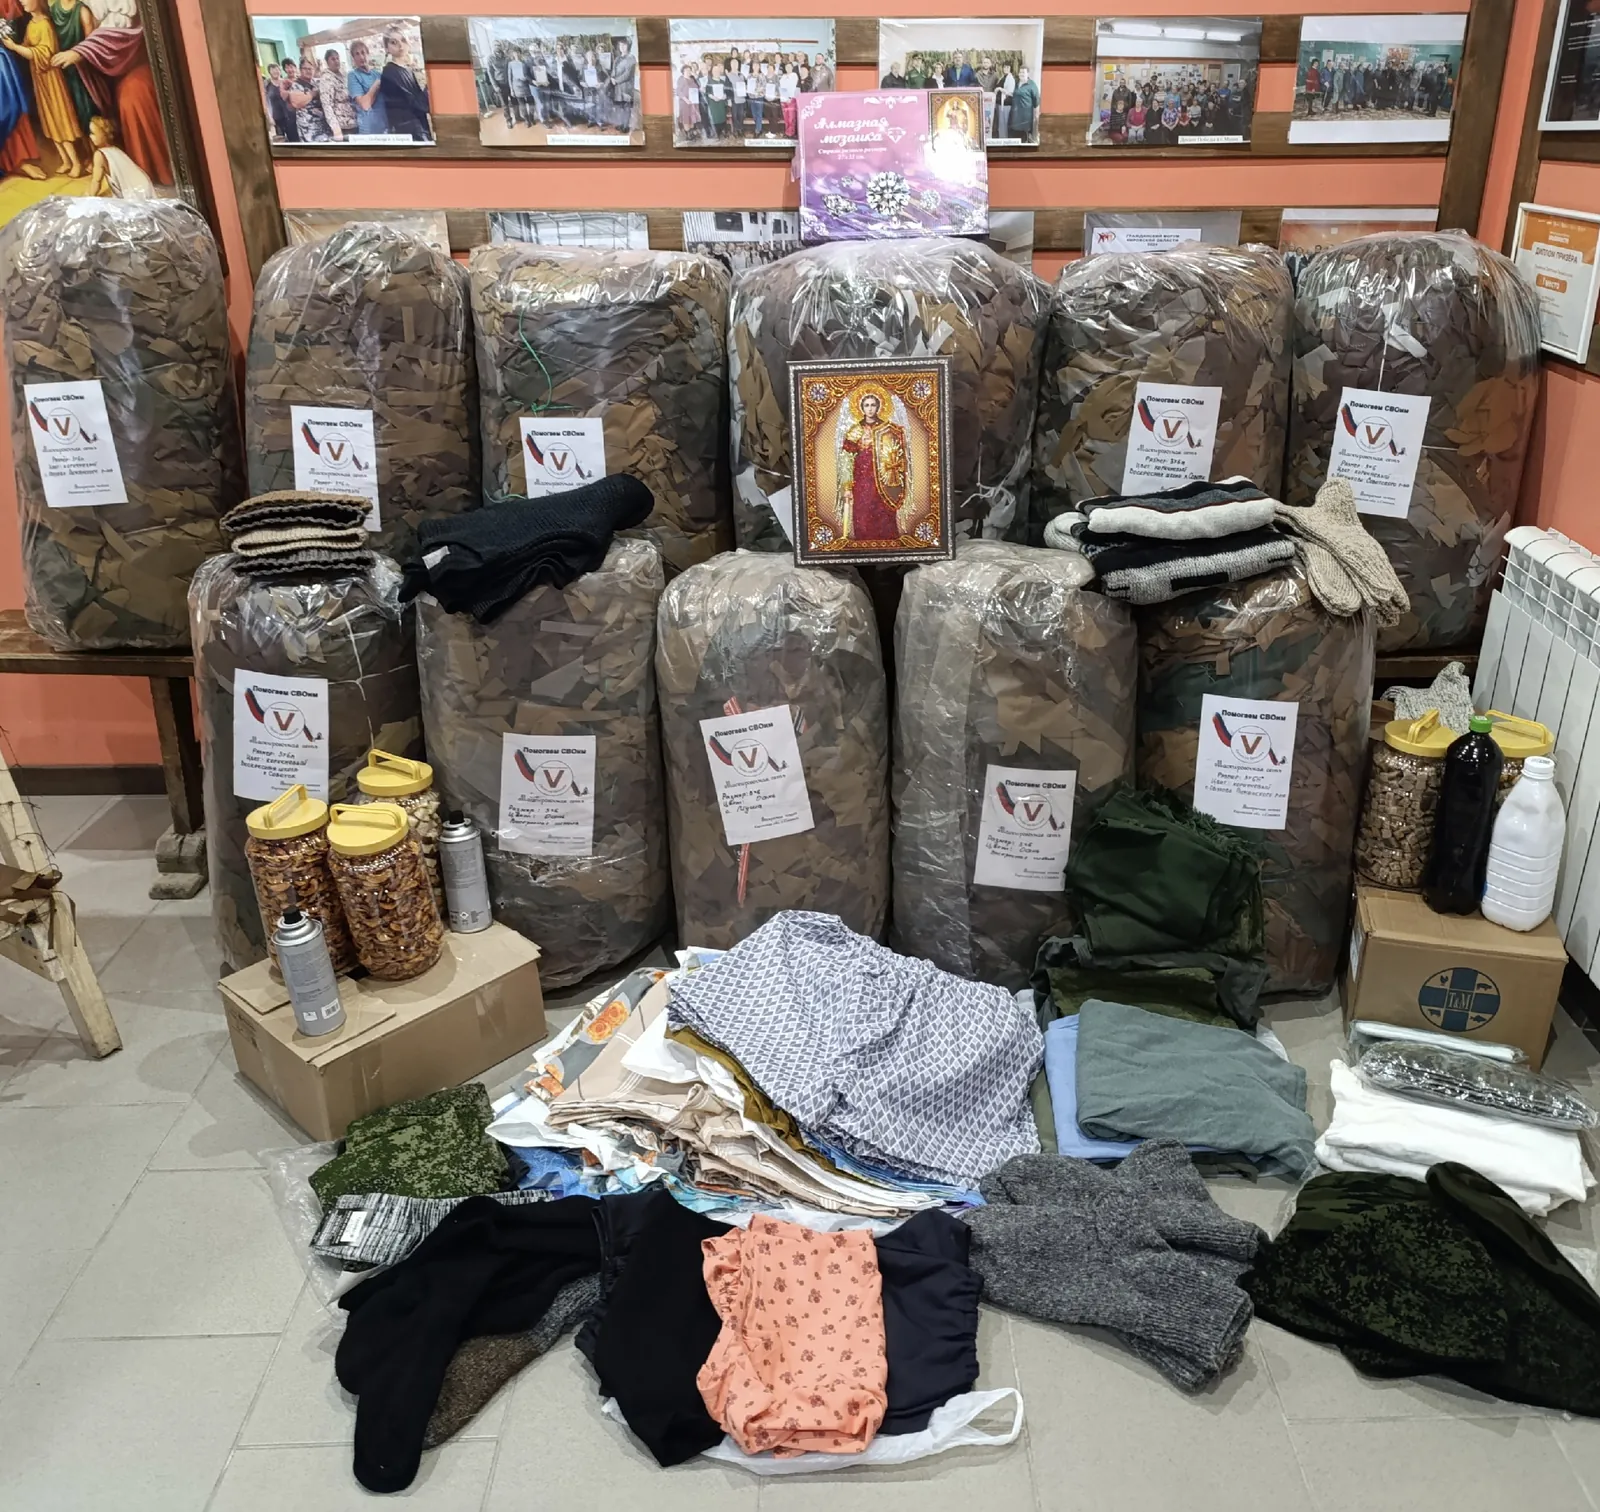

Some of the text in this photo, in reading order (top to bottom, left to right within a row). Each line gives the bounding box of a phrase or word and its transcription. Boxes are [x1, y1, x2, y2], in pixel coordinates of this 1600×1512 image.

[814, 117, 889, 132] Алмазная
[820, 132, 882, 146] мозаика
[1535, 246, 1555, 259] ДИПЛОМ
[1147, 396, 1179, 404] Помогаем
[1350, 401, 1409, 414] Помогаем СВОим
[308, 419, 338, 427] Помогаем
[253, 685, 318, 698] Помогаем СВОим
[1222, 710, 1257, 719] Помогаем
[715, 722, 774, 738] Помогаем СВОим
[249, 736, 299, 749] Маскировочная
[1214, 759, 1264, 773] Маскировочная
[724, 777, 769, 788] Маскировочная
[1005, 780, 1040, 788] Помогаем
